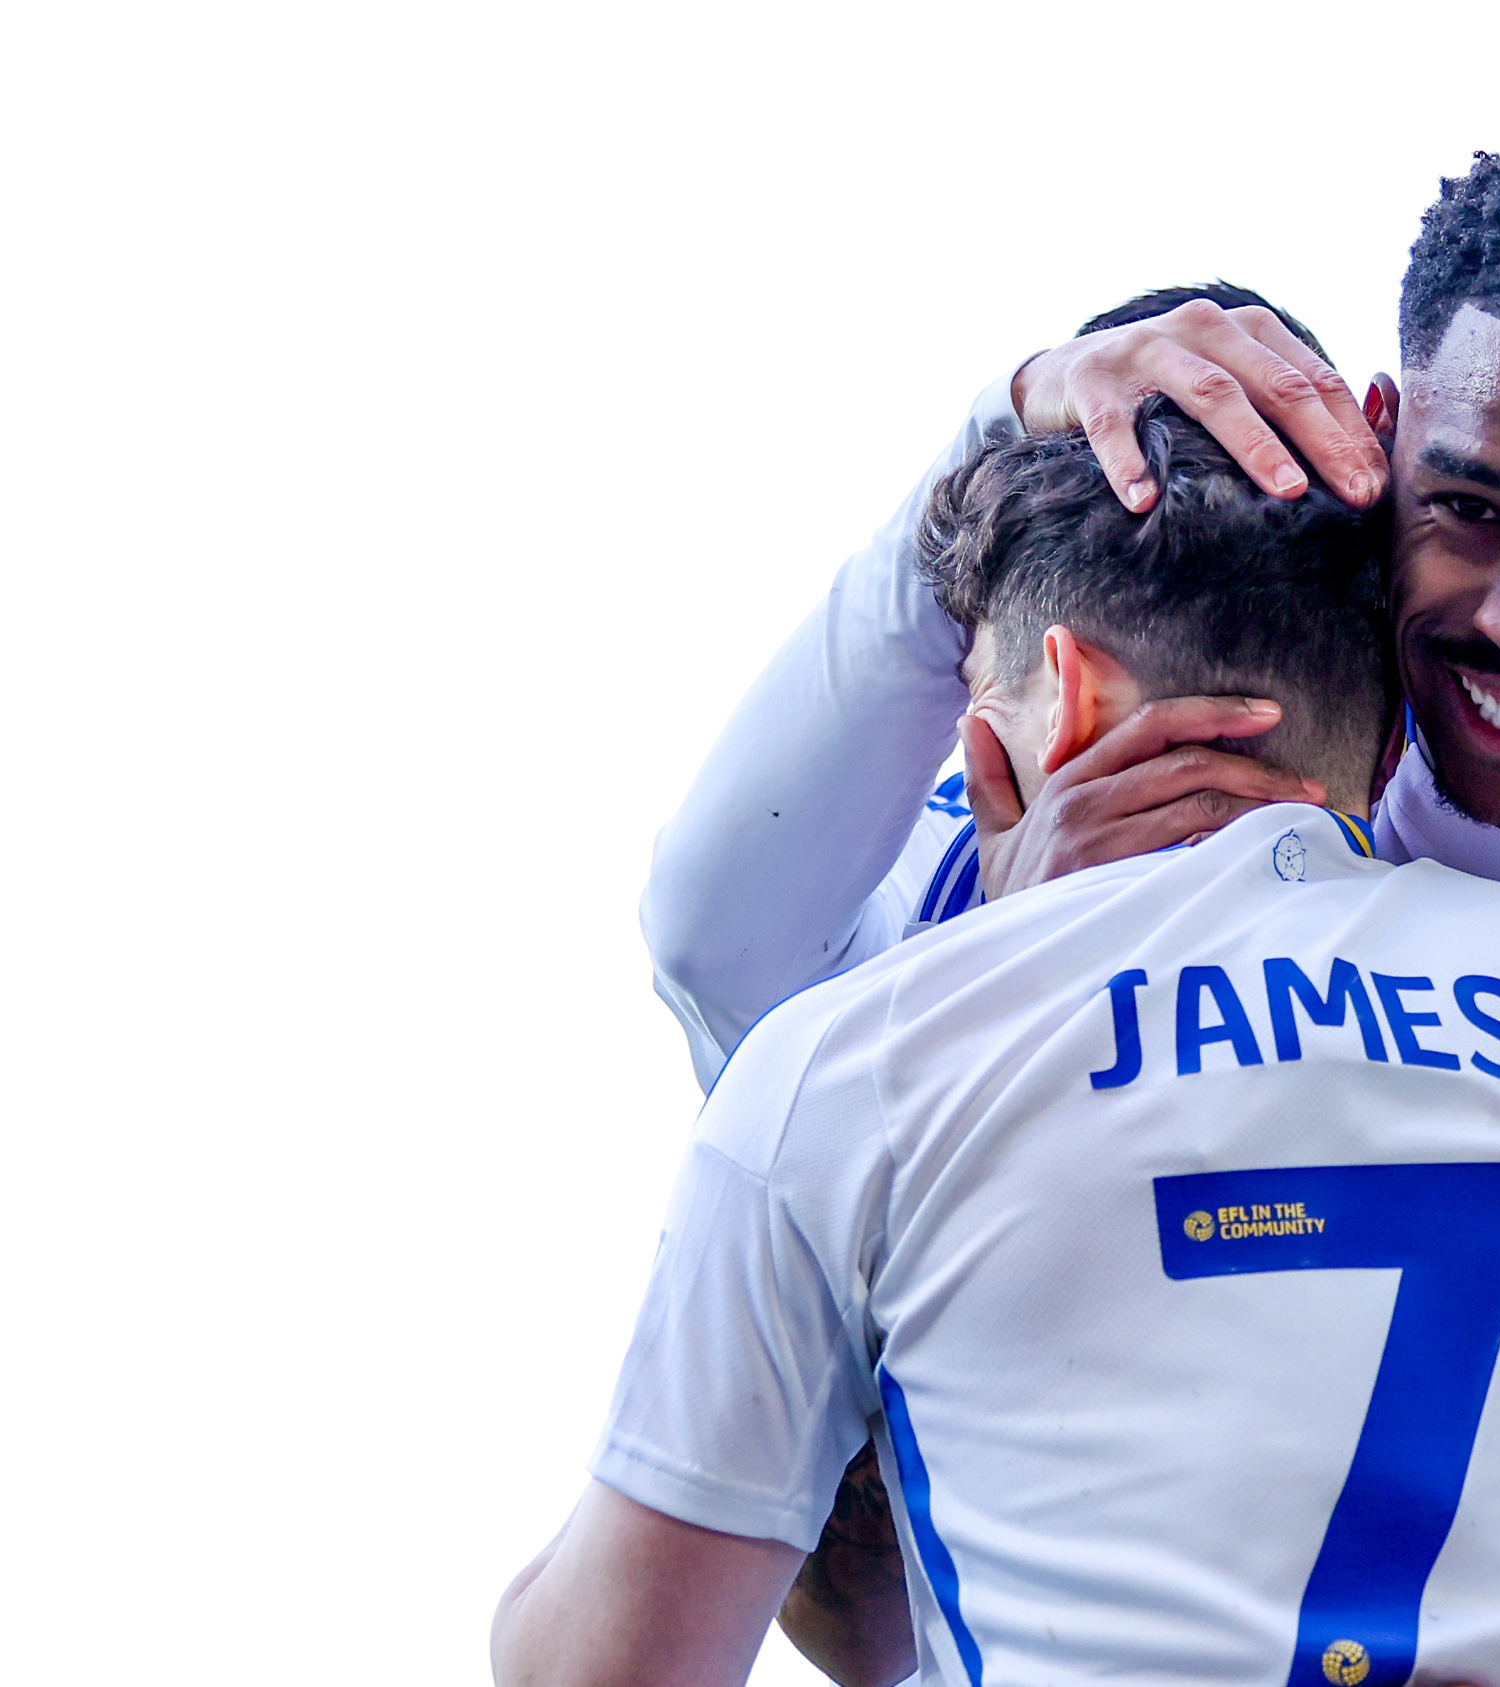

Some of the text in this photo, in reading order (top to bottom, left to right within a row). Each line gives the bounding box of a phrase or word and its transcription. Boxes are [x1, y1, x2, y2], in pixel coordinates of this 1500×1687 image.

[1217, 1202, 1307, 1224] EFL IN THE
[1220, 1217, 1326, 1240] COMMUNITY
